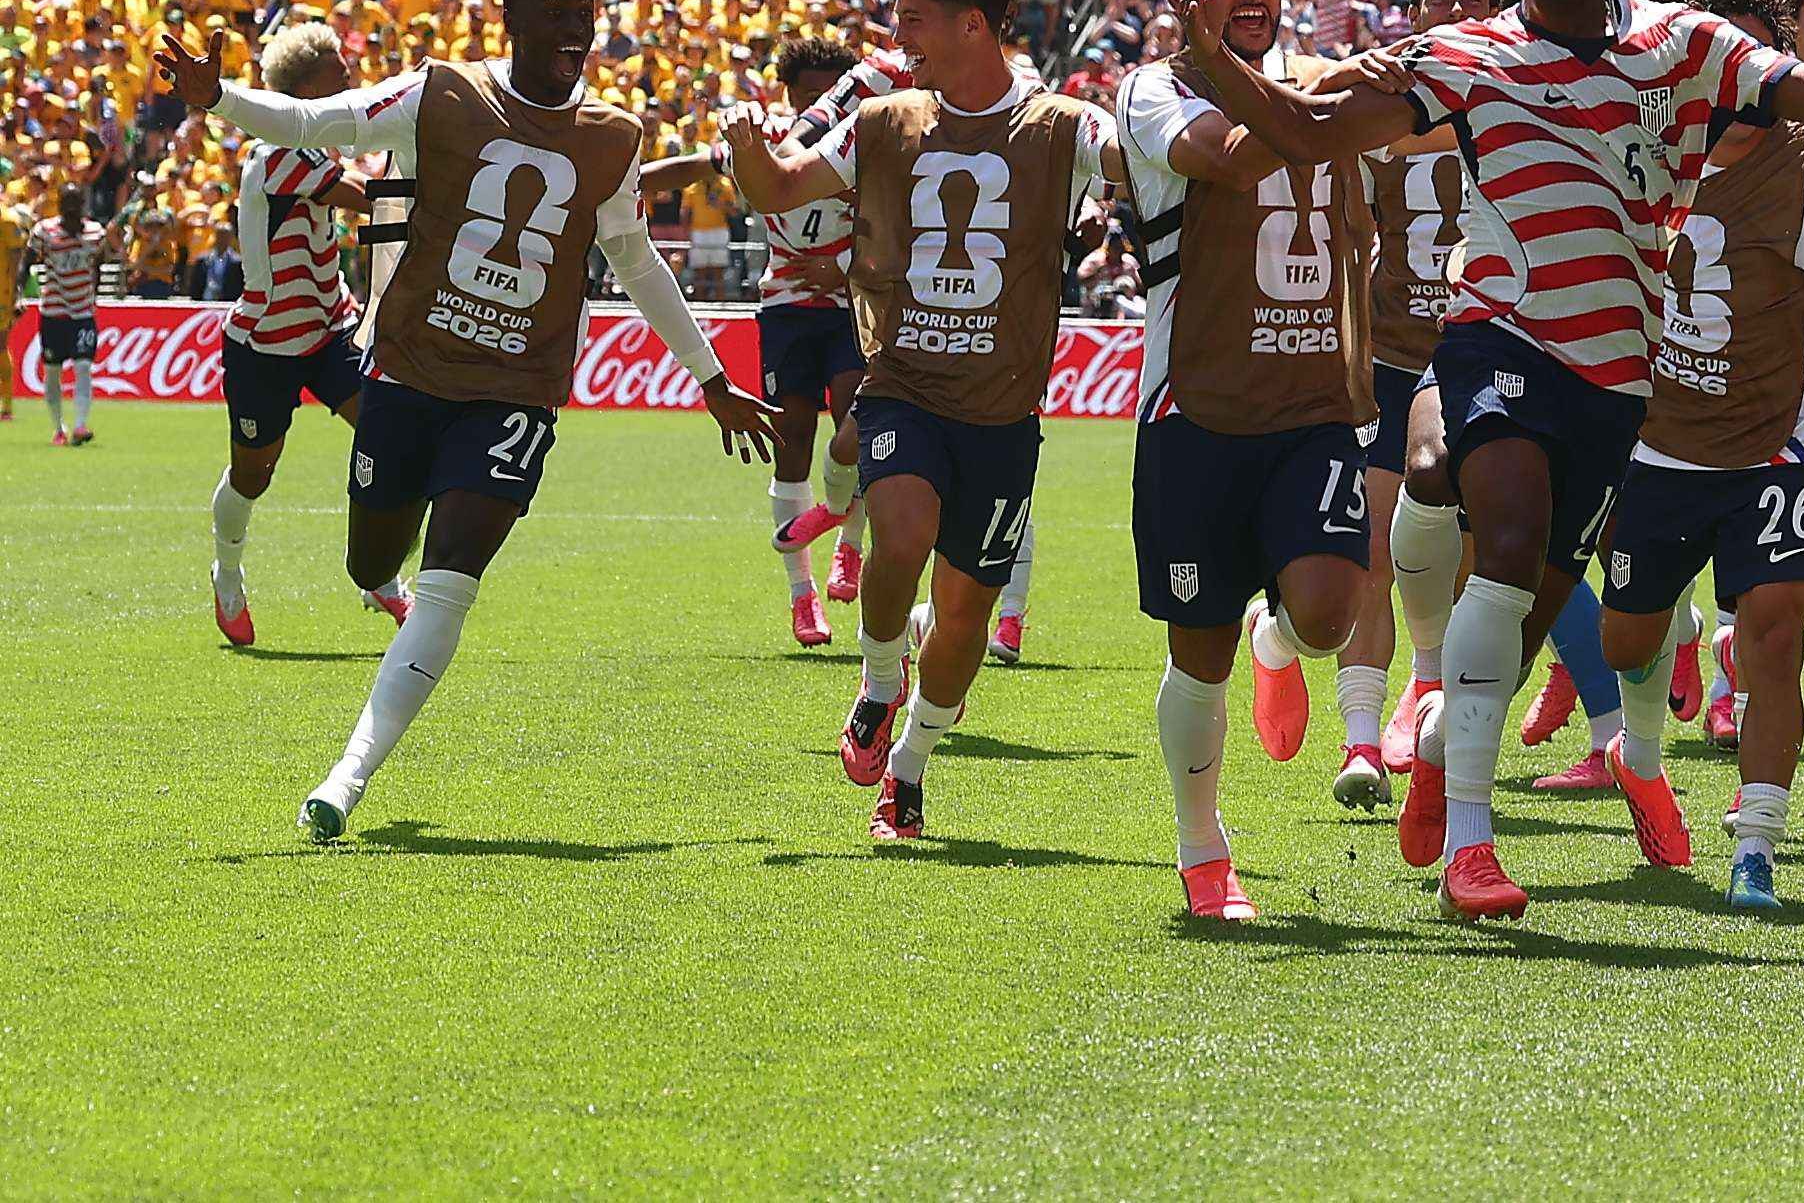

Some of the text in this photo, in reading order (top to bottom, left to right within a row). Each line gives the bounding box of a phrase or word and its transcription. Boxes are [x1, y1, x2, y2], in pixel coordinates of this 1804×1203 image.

[1640, 89, 1669, 110] USA
[801, 208, 822, 244] 4
[473, 265, 519, 294] FIFA
[932, 276, 976, 295] FIFA
[1285, 265, 1320, 284] FIFA
[436, 289, 534, 331] WORLD CUP
[902, 308, 998, 331] WORLD CUP
[1254, 307, 1334, 325] WORLD CUP
[1408, 298, 1450, 319] 20
[426, 306, 528, 355] 2026
[895, 325, 995, 355] 2026
[1251, 326, 1339, 355] 2026
[1657, 342, 1731, 375] ORLD CUP
[1655, 355, 1728, 397] 026
[487, 411, 547, 470] 21
[981, 498, 1030, 551] 14
